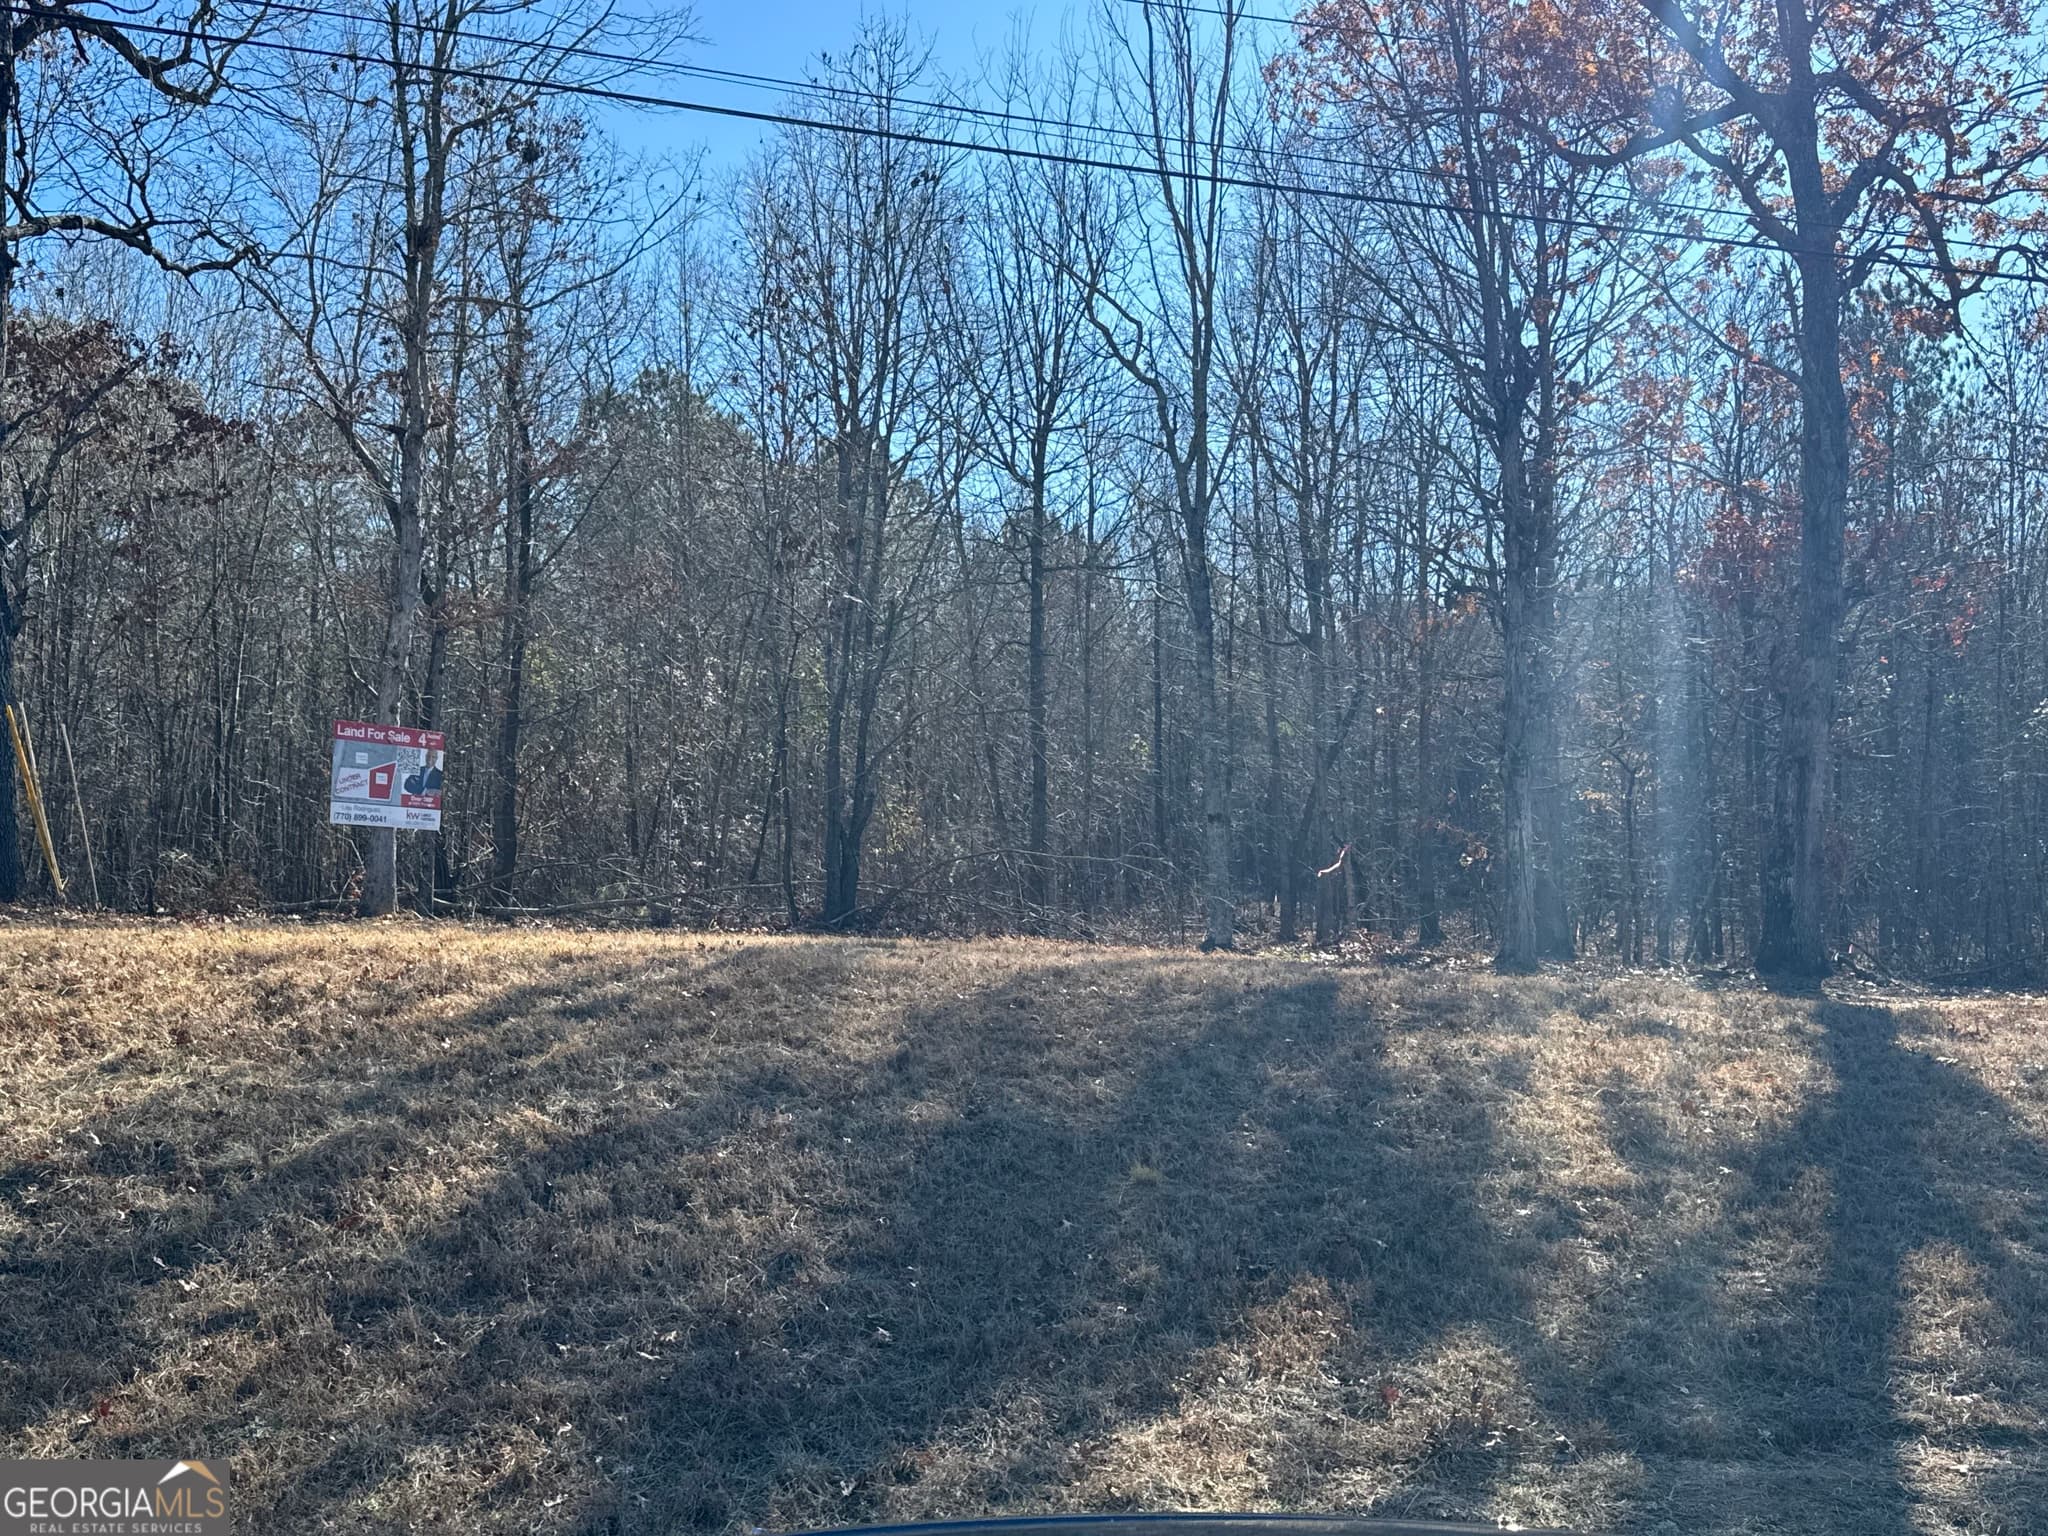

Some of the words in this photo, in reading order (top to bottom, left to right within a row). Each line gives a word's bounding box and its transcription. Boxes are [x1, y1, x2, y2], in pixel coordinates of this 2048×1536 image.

[337, 724, 365, 738] Land
[367, 728, 386, 740] For
[387, 730, 411, 743] Sale
[418, 733, 427, 746] 4
[406, 809, 420, 819] kw
